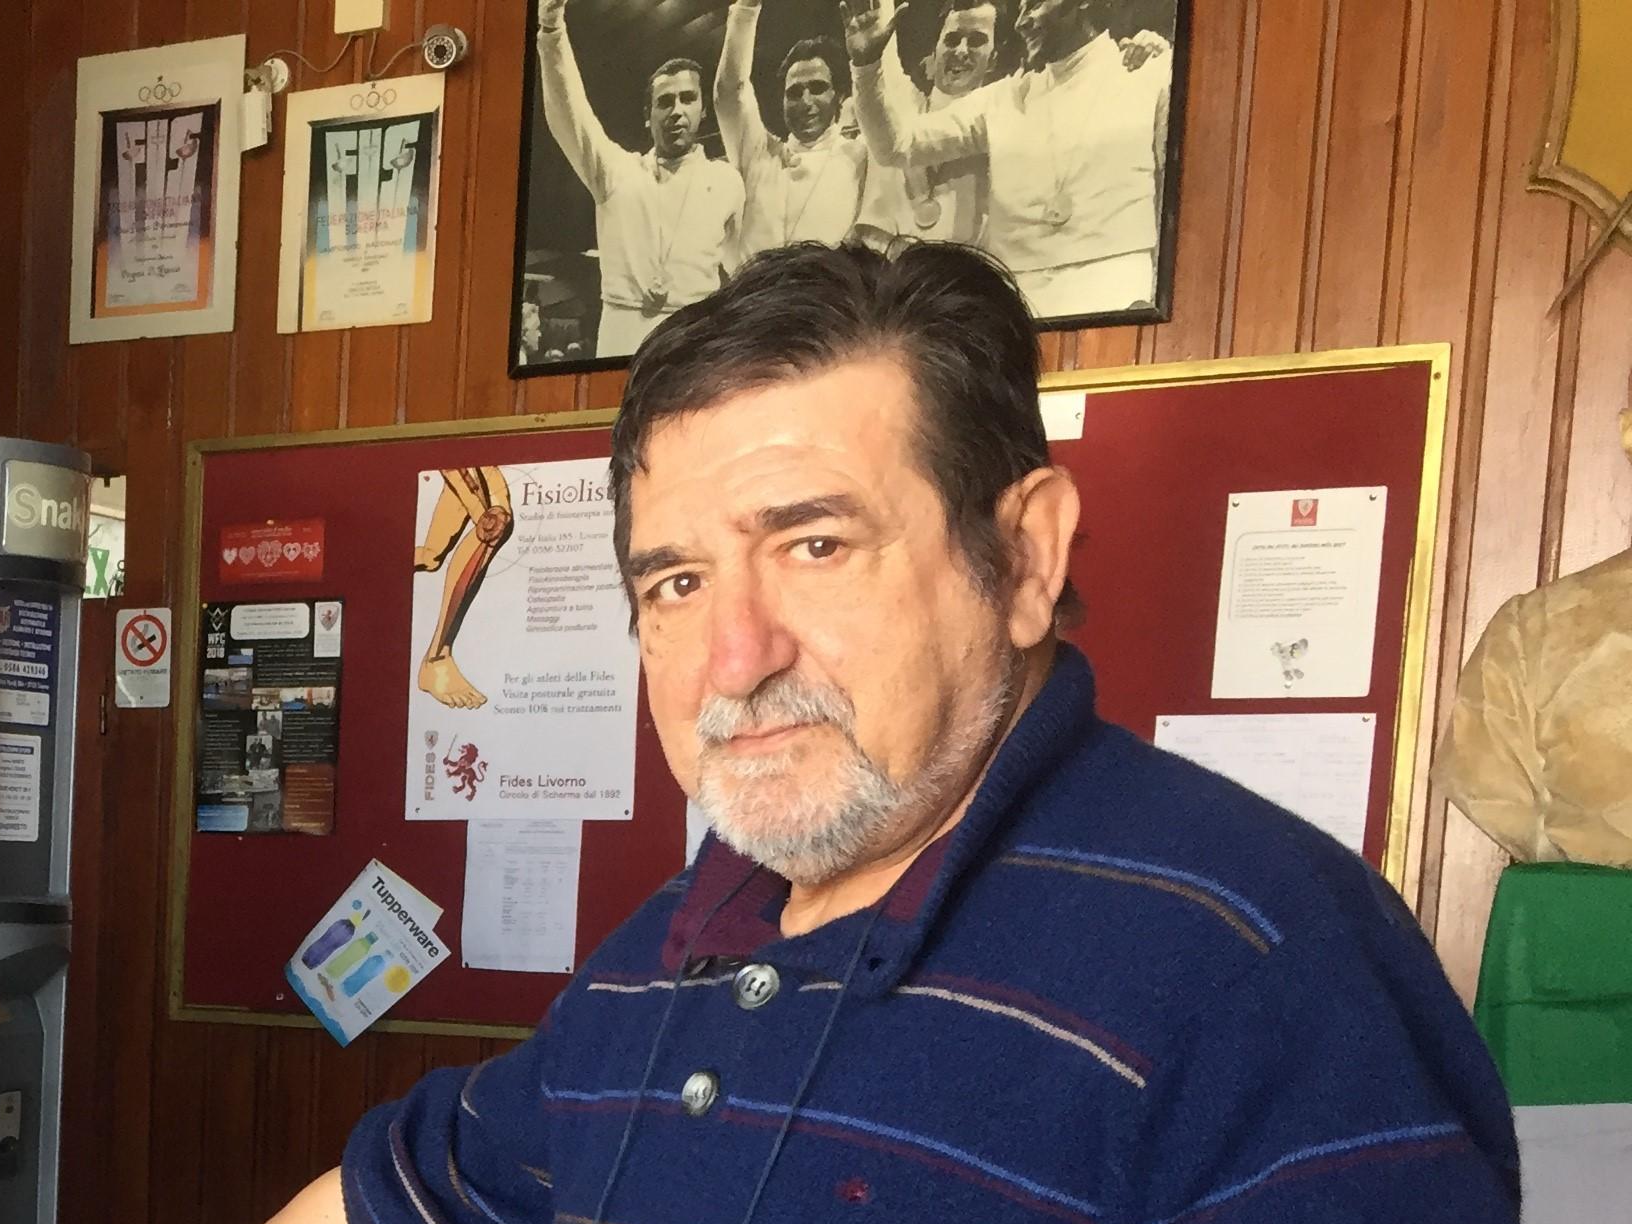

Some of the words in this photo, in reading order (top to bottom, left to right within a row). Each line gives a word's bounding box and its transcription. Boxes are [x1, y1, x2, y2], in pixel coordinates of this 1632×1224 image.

[207, 632, 226, 644] WFC
[504, 673, 519, 684] Per
[521, 673, 533, 686] gli
[536, 672, 561, 683] atleti
[564, 671, 587, 682] della
[590, 670, 615, 682] Fides
[502, 688, 528, 699] Visita
[531, 687, 575, 701] posturale
[577, 688, 616, 699] gratuita
[494, 703, 526, 715] Sconto
[528, 703, 548, 714] 10%
[567, 703, 623, 713] trattamenti
[424, 751, 437, 801] FIDES
[499, 774, 533, 788] Fides
[537, 774, 587, 788] Livorno
[499, 790, 529, 799] Circolo
[531, 789, 540, 799] di
[542, 790, 581, 799] Scherma
[371, 875, 440, 958] Tupperware
